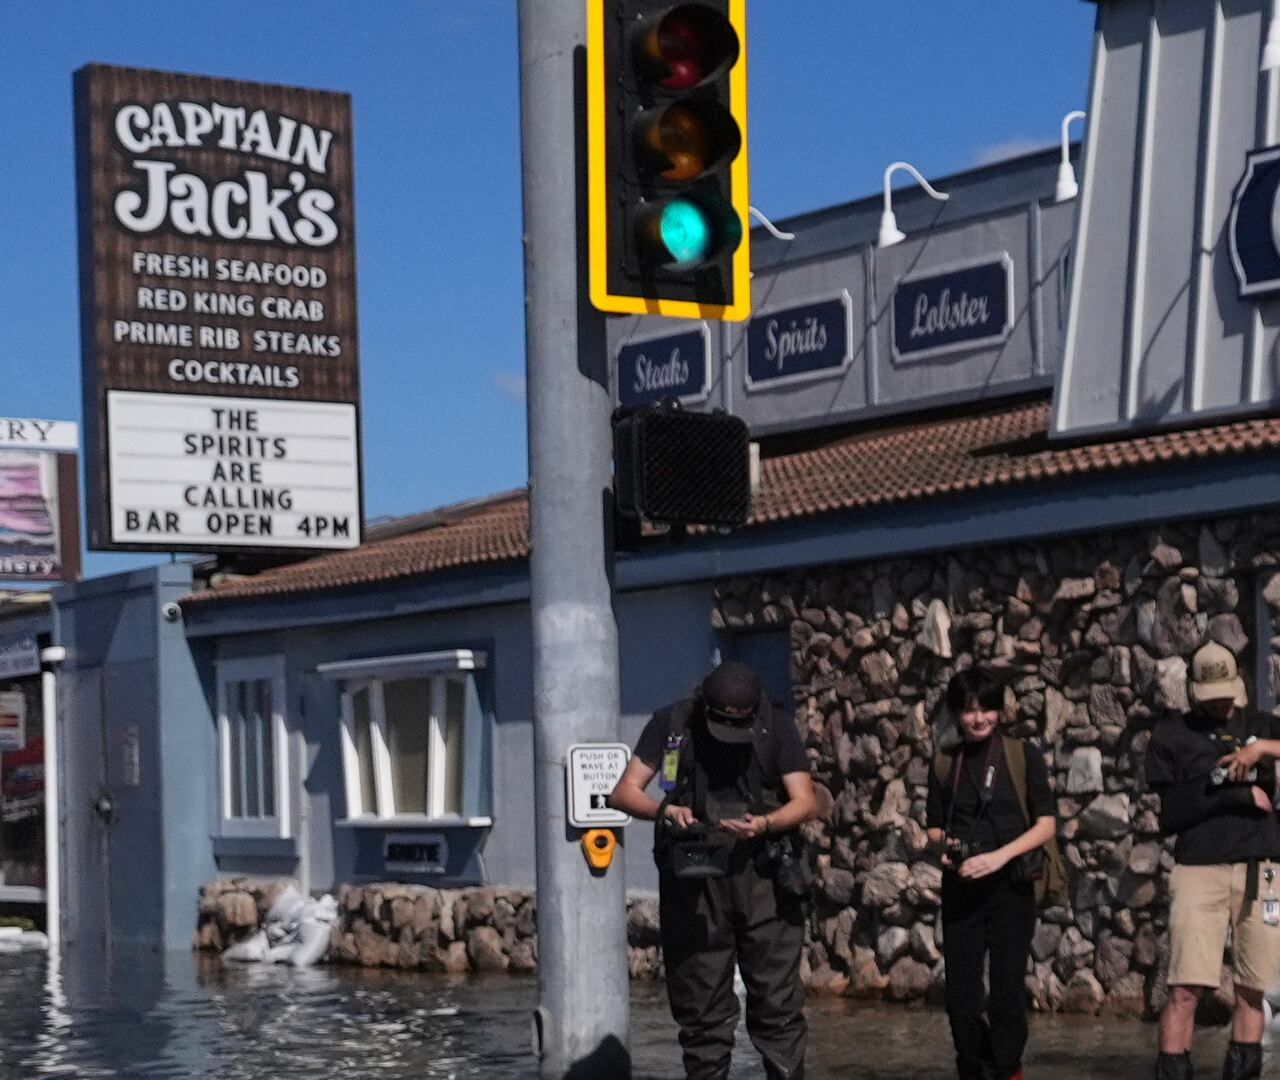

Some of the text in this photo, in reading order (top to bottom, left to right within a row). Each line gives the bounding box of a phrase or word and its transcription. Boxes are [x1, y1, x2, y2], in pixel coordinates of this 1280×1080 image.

[115, 102, 333, 173] CAPTAIN
[115, 160, 338, 246] Jack's
[132, 252, 328, 288] FRESH SEAFOOD
[137, 287, 325, 321] RED KING CRAB
[909, 288, 991, 339] Lobster
[113, 320, 342, 357] PRIME RIB STEAKS
[763, 316, 829, 370] Spirits
[168, 359, 300, 388] COCKTAILS
[632, 347, 689, 393] Steaks
[0, 419, 56, 441] RY
[212, 408, 259, 432] THE
[183, 433, 287, 459] SPIRITS
[212, 462, 262, 483] ARE
[183, 486, 293, 510] CALLING
[125, 511, 350, 537] BAR OPEN 4PM
